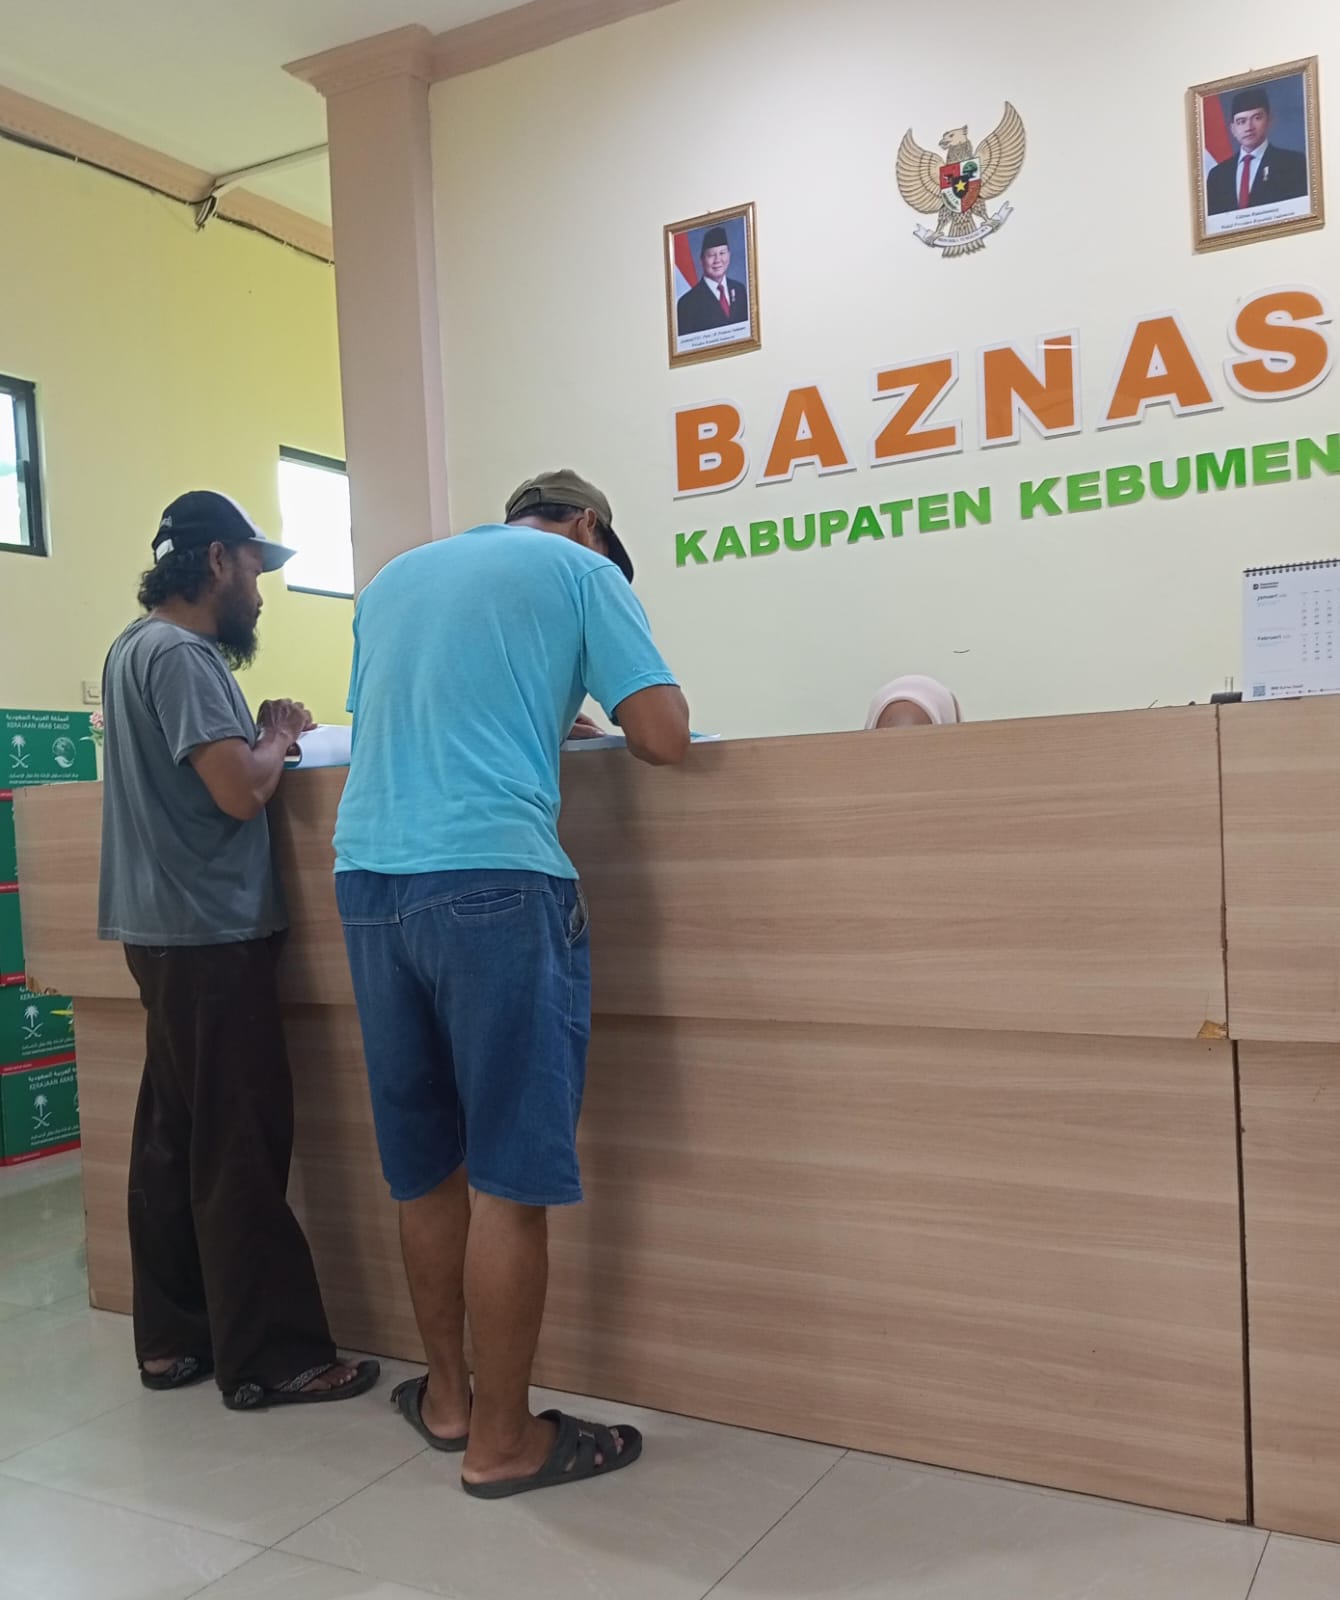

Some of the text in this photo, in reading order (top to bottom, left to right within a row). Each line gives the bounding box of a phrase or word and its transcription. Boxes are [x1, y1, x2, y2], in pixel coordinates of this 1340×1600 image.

[674, 291, 1329, 493] BAZNAS
[676, 434, 1340, 566] KABUPATEN KEBUMEN
[29, 1079, 59, 1091] KERAJAAN
